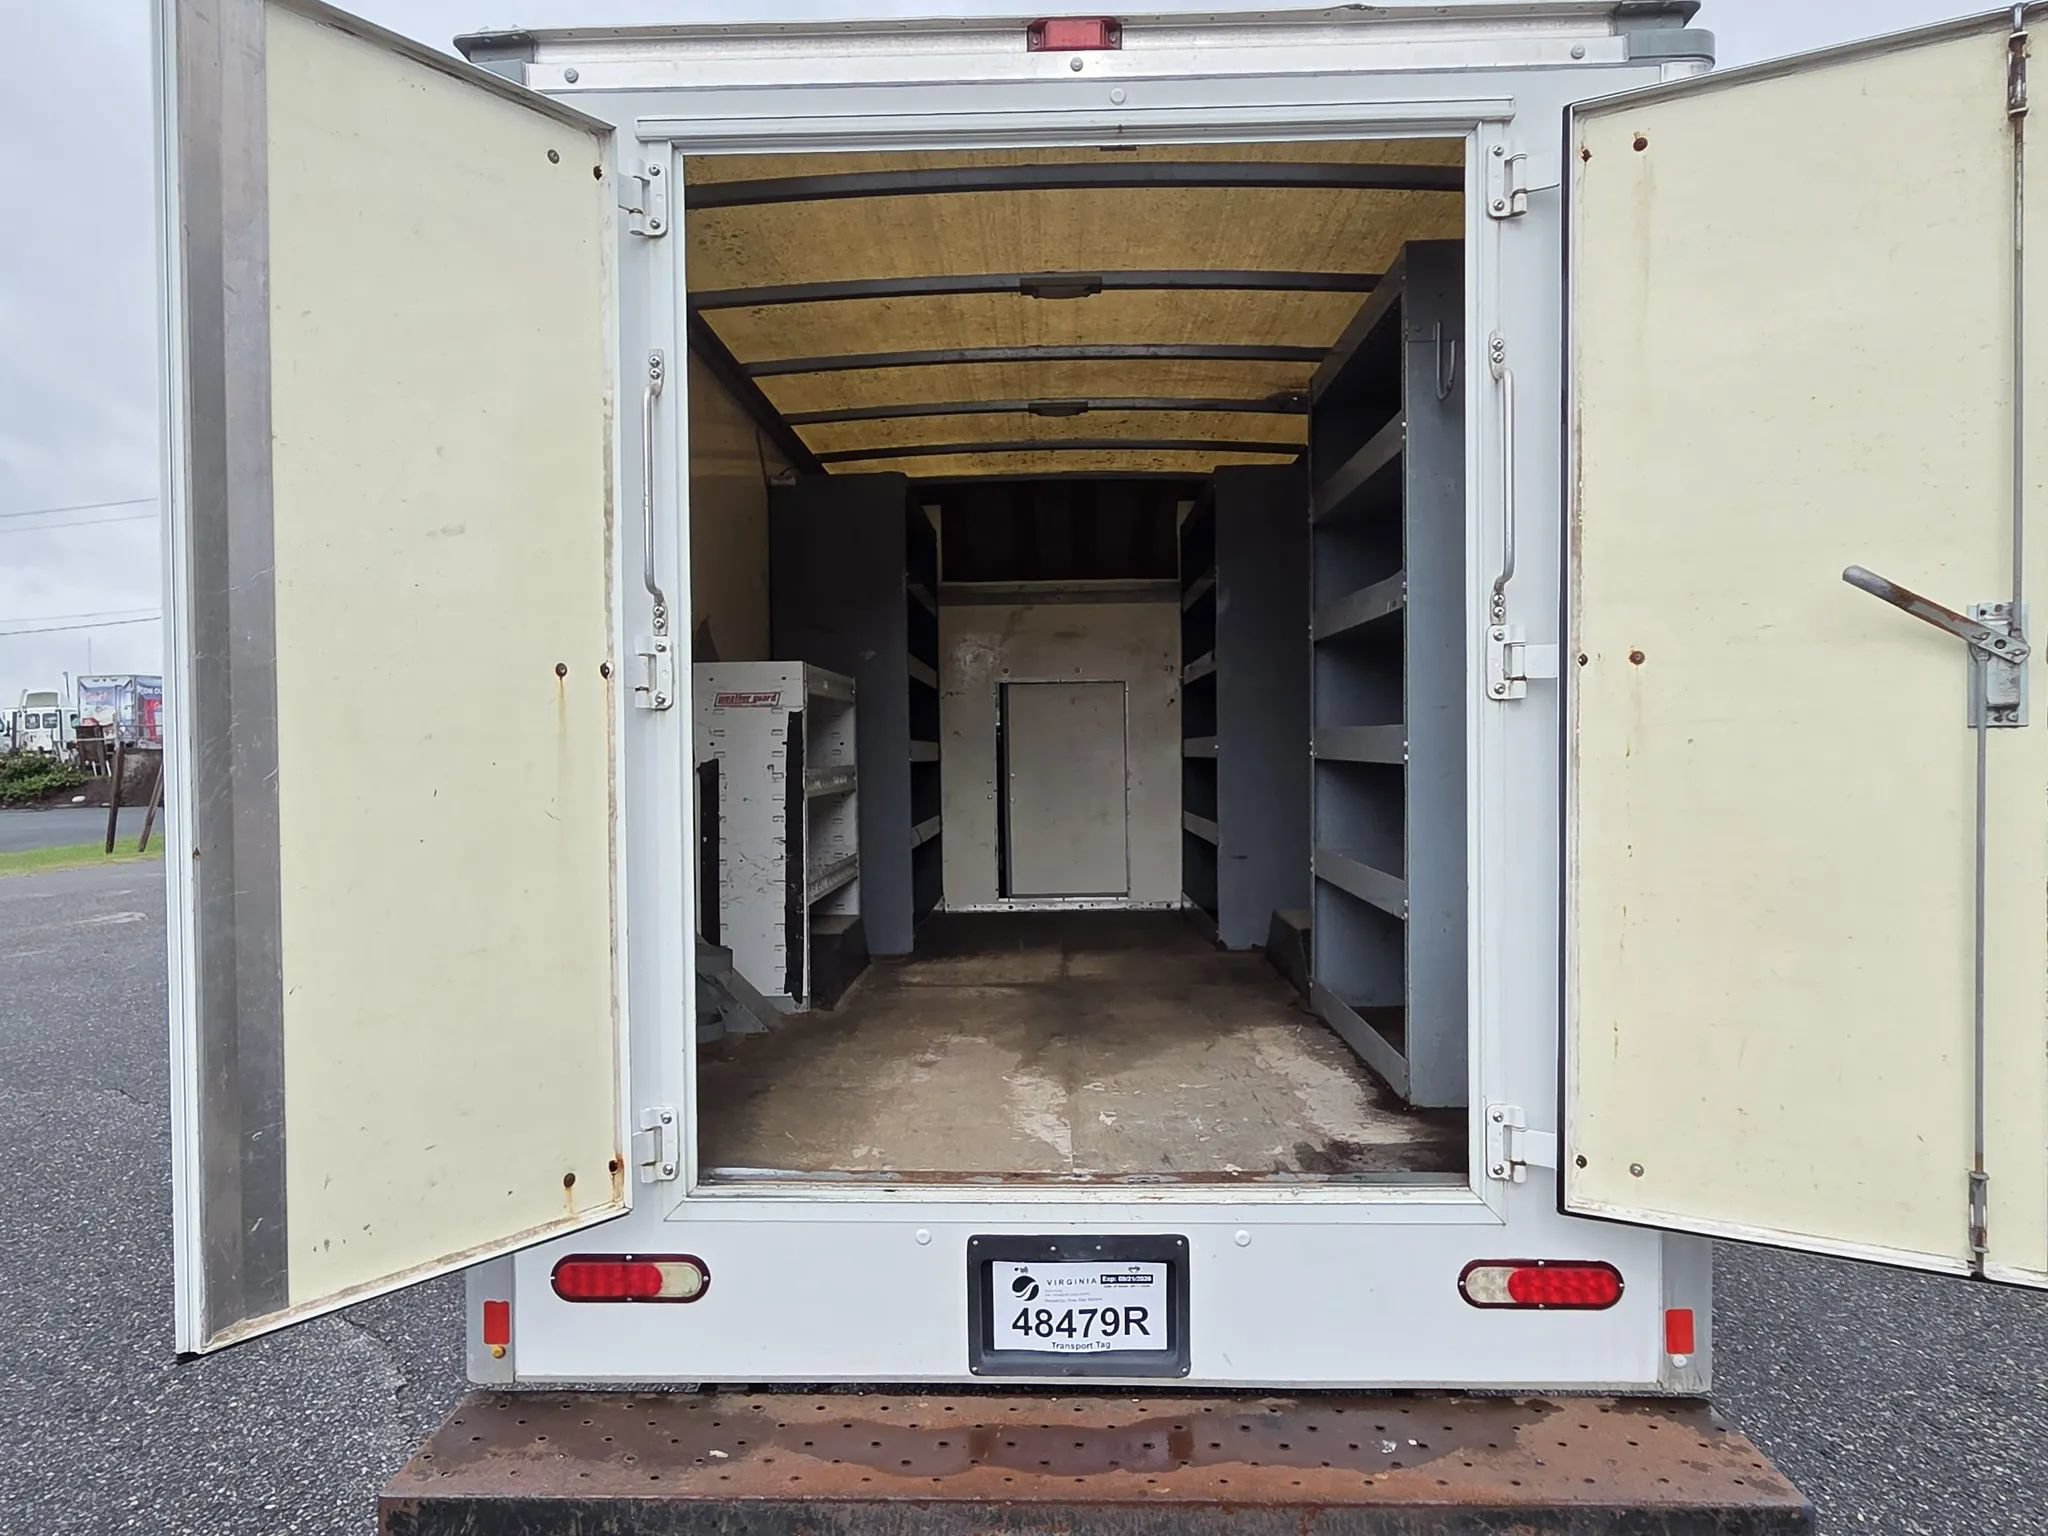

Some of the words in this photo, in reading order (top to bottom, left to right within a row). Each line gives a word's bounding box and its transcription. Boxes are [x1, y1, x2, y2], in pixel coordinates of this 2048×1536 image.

[752, 692, 777, 704] guard
[1046, 1278, 1097, 1286] VIRGINIA
[1012, 1306, 1151, 1339] 48479R
[1051, 1341, 1093, 1350] Transport
[1095, 1340, 1111, 1350] Tag
